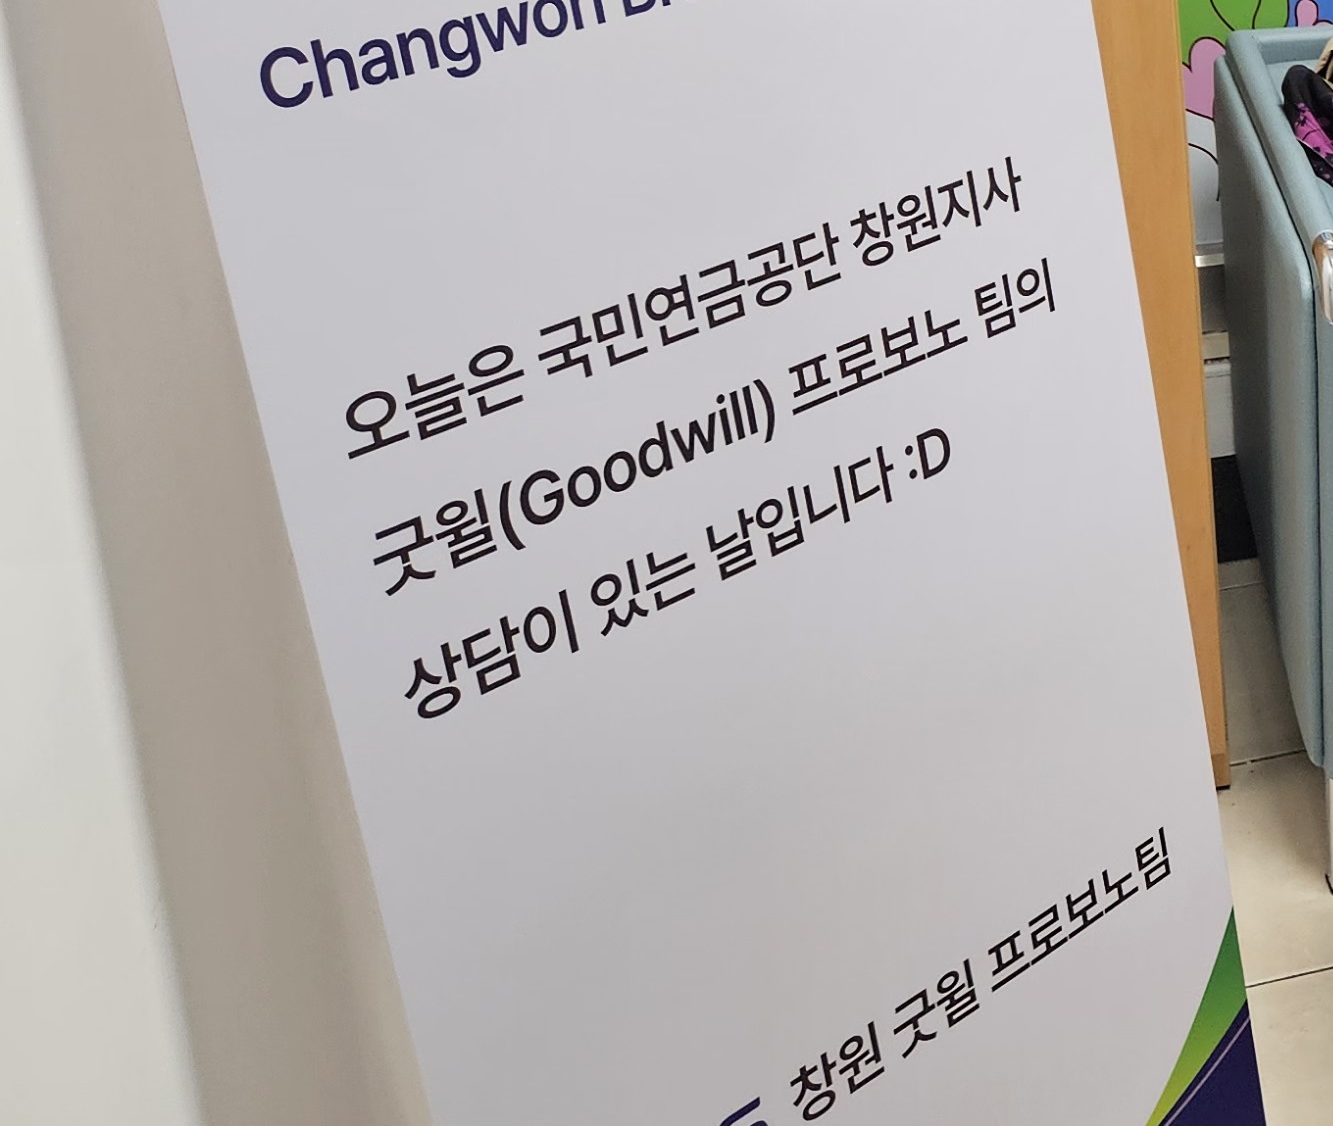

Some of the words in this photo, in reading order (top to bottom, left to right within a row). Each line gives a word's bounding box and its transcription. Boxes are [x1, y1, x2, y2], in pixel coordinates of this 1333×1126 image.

[344, 343, 526, 461] 오늘은
[536, 221, 843, 379] 국민연금공단
[848, 155, 1023, 268] 창원지사
[371, 377, 777, 598] 굿윌(Goodwill)
[787, 308, 970, 417] 프로보노
[973, 256, 1057, 340] 팀의
[403, 587, 581, 720] 상담이
[589, 551, 697, 638] 있는
[704, 444, 895, 582] 날입니다
[903, 427, 952, 481] :D
[788, 1019, 886, 1123] 창원
[892, 957, 981, 1060] 굿윌
[986, 825, 1173, 994] 프로보노팀
